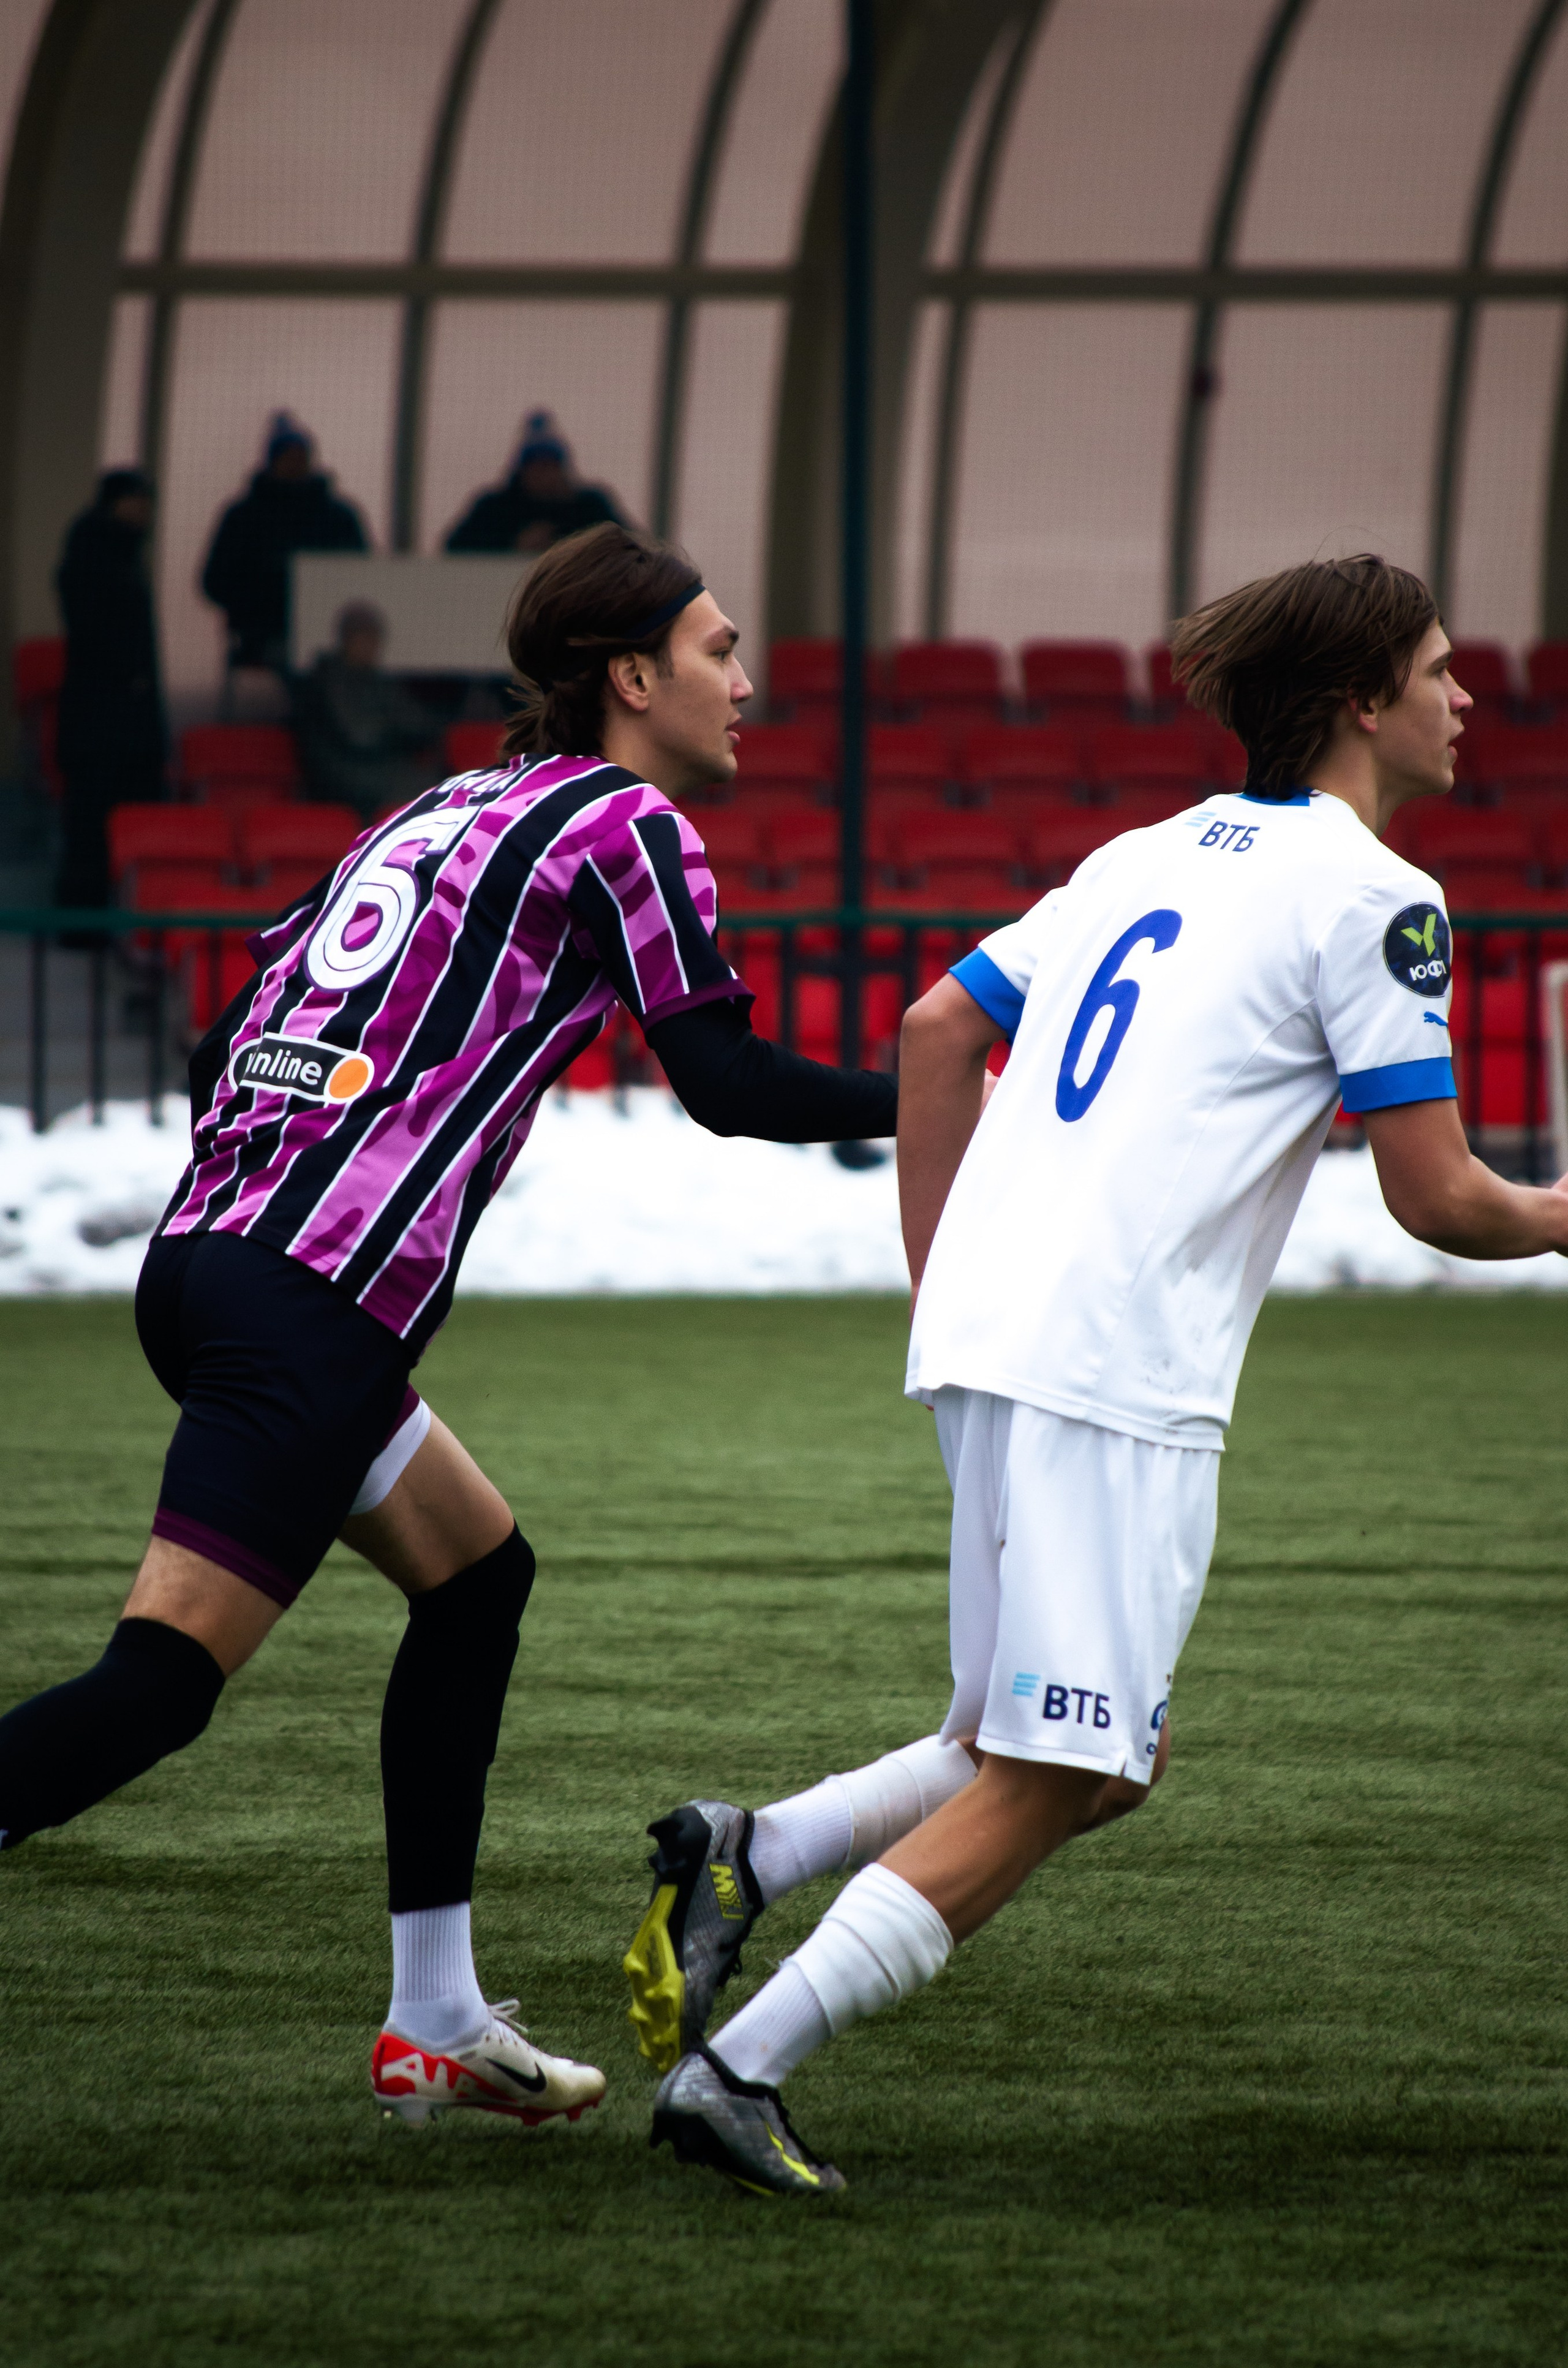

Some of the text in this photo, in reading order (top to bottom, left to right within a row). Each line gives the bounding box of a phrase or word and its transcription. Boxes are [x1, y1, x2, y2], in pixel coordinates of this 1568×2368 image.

[1198, 820, 1261, 852] ВТБ
[304, 803, 482, 993] 6
[1055, 909, 1183, 1122] 6
[1042, 1684, 1111, 1730] ВТБ
